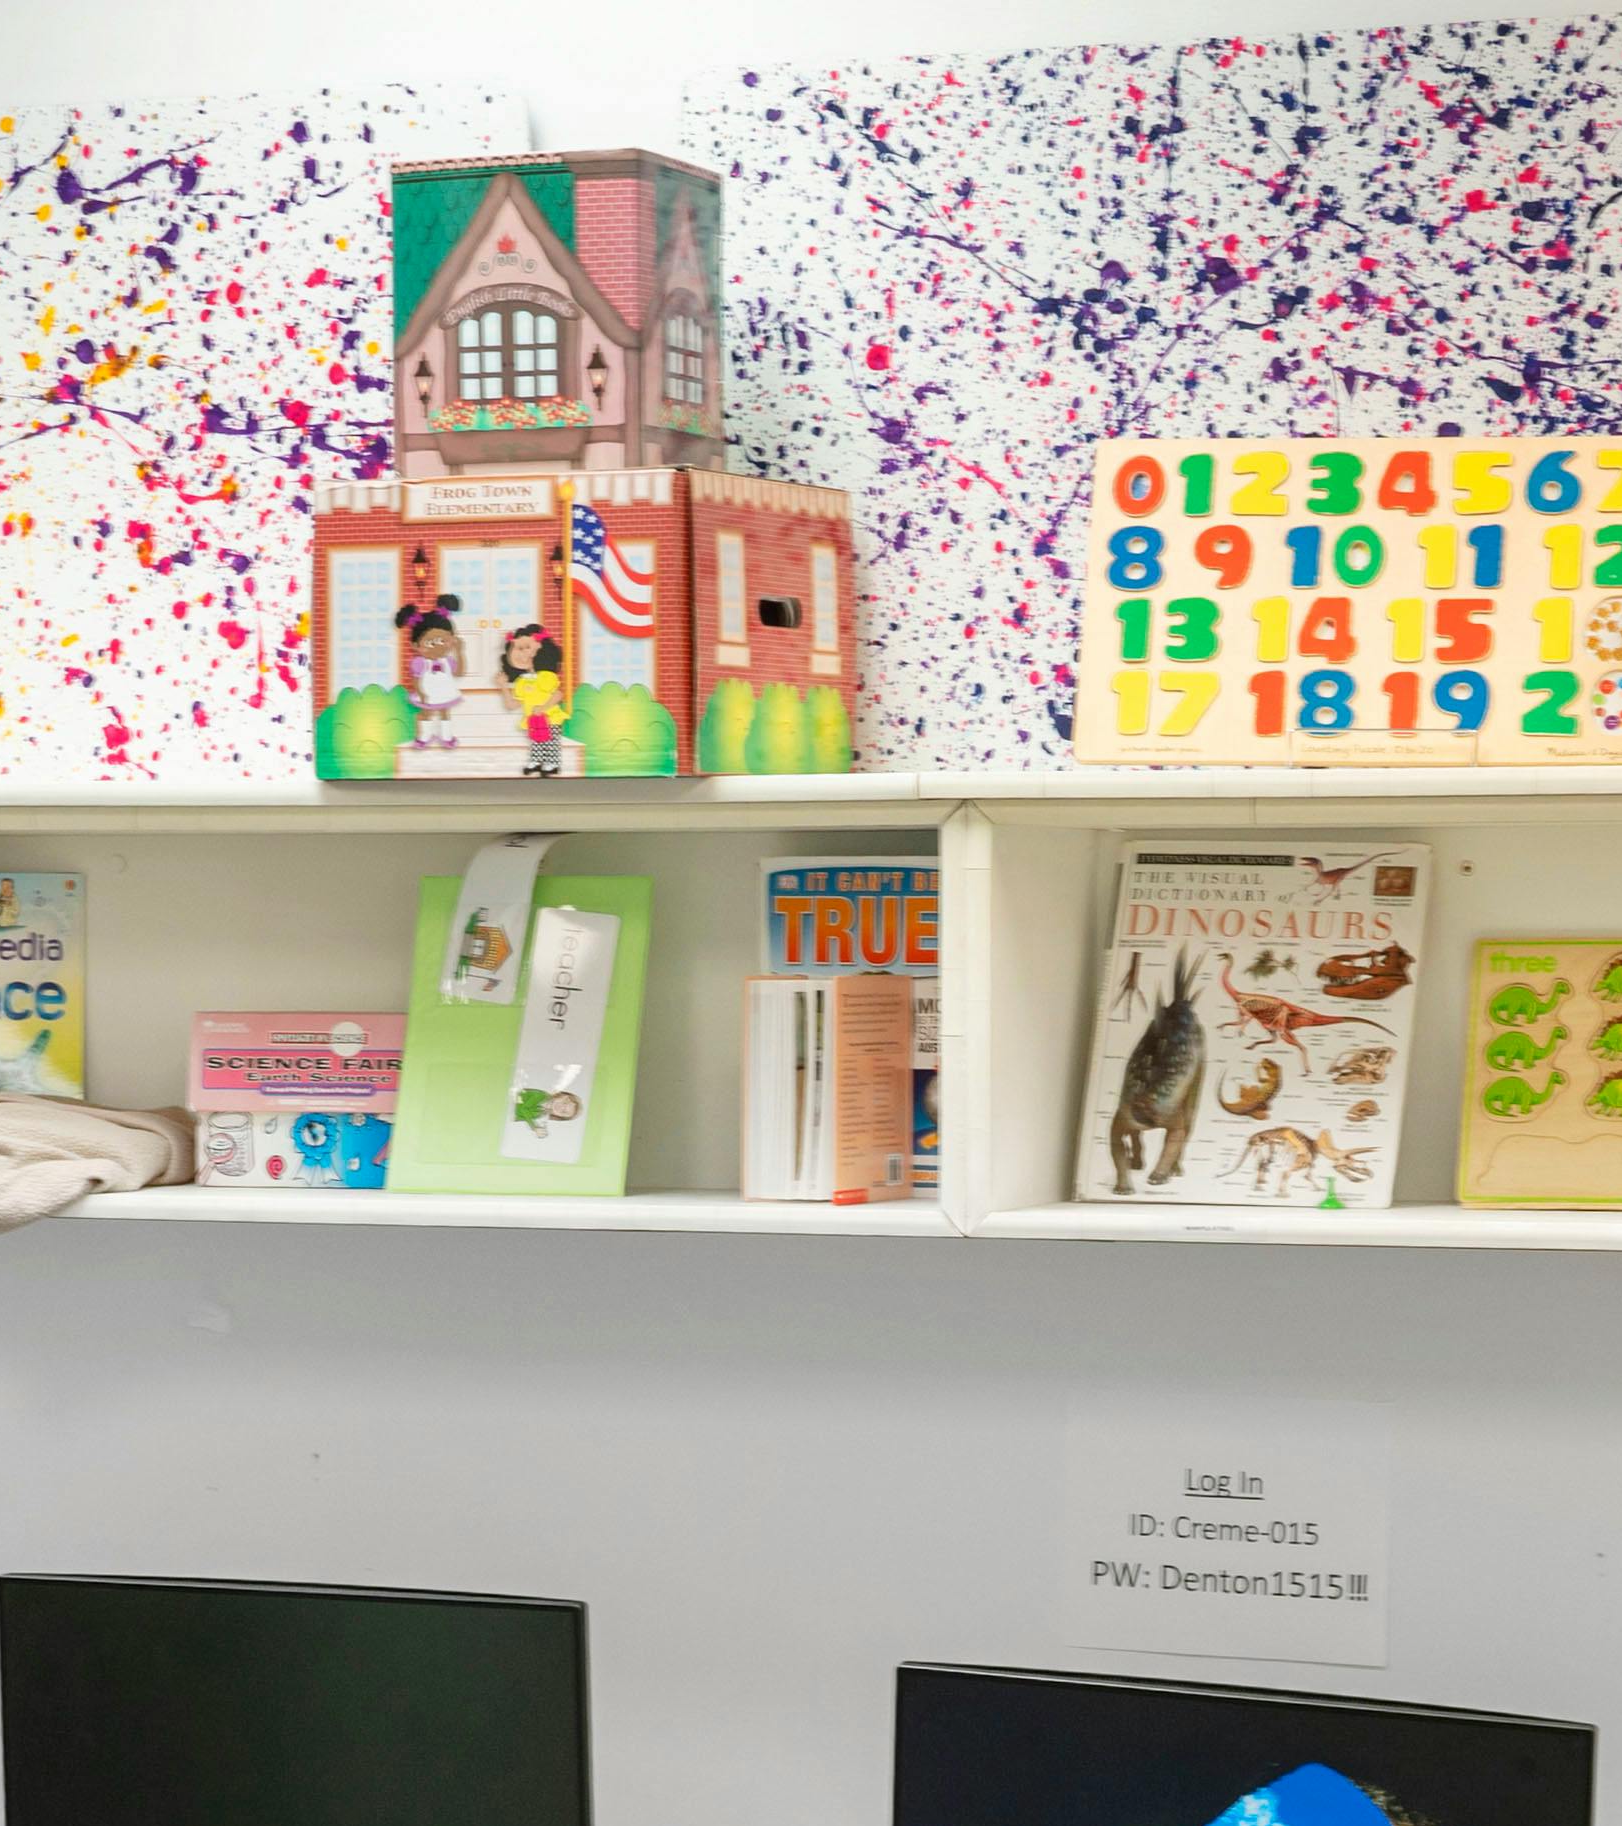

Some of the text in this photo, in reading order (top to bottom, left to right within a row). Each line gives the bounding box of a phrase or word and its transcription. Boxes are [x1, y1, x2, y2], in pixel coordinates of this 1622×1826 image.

[430, 484, 532, 499] FROG TOWN
[1112, 455, 1166, 517] 0
[1179, 453, 1215, 517] 1
[1230, 451, 1291, 516] 2
[1306, 451, 1364, 516] 3
[1377, 450, 1438, 516] 4
[1453, 451, 1513, 514] 5
[1524, 450, 1583, 515] 6
[426, 501, 538, 515] ELEMENTARY
[1106, 525, 1165, 592] 8
[1194, 524, 1253, 590] 9
[1286, 524, 1386, 590] 10
[1418, 524, 1504, 590] 11
[1115, 597, 1221, 663] 13
[1251, 596, 1358, 664] 14
[1385, 597, 1495, 664] 15
[1111, 668, 1221, 736] 17
[1249, 669, 1358, 737] 18
[1381, 669, 1491, 737] 19
[805, 871, 829, 892] IT
[836, 871, 903, 892] CAN'T
[1133, 871, 1265, 885] THE VISUAL
[1131, 888, 1269, 903] DICTIONARY
[773, 895, 940, 967] TRUE
[1127, 903, 1394, 941] DINOSAURS
[1488, 951, 1557, 973] three
[206, 1056, 332, 1070] SCIENCE
[246, 1072, 392, 1083] Earth Science
[1185, 1468, 1263, 1496] Log In
[1129, 1513, 1319, 1546] ID: Creme-015
[1090, 1560, 1151, 1589] PW:
